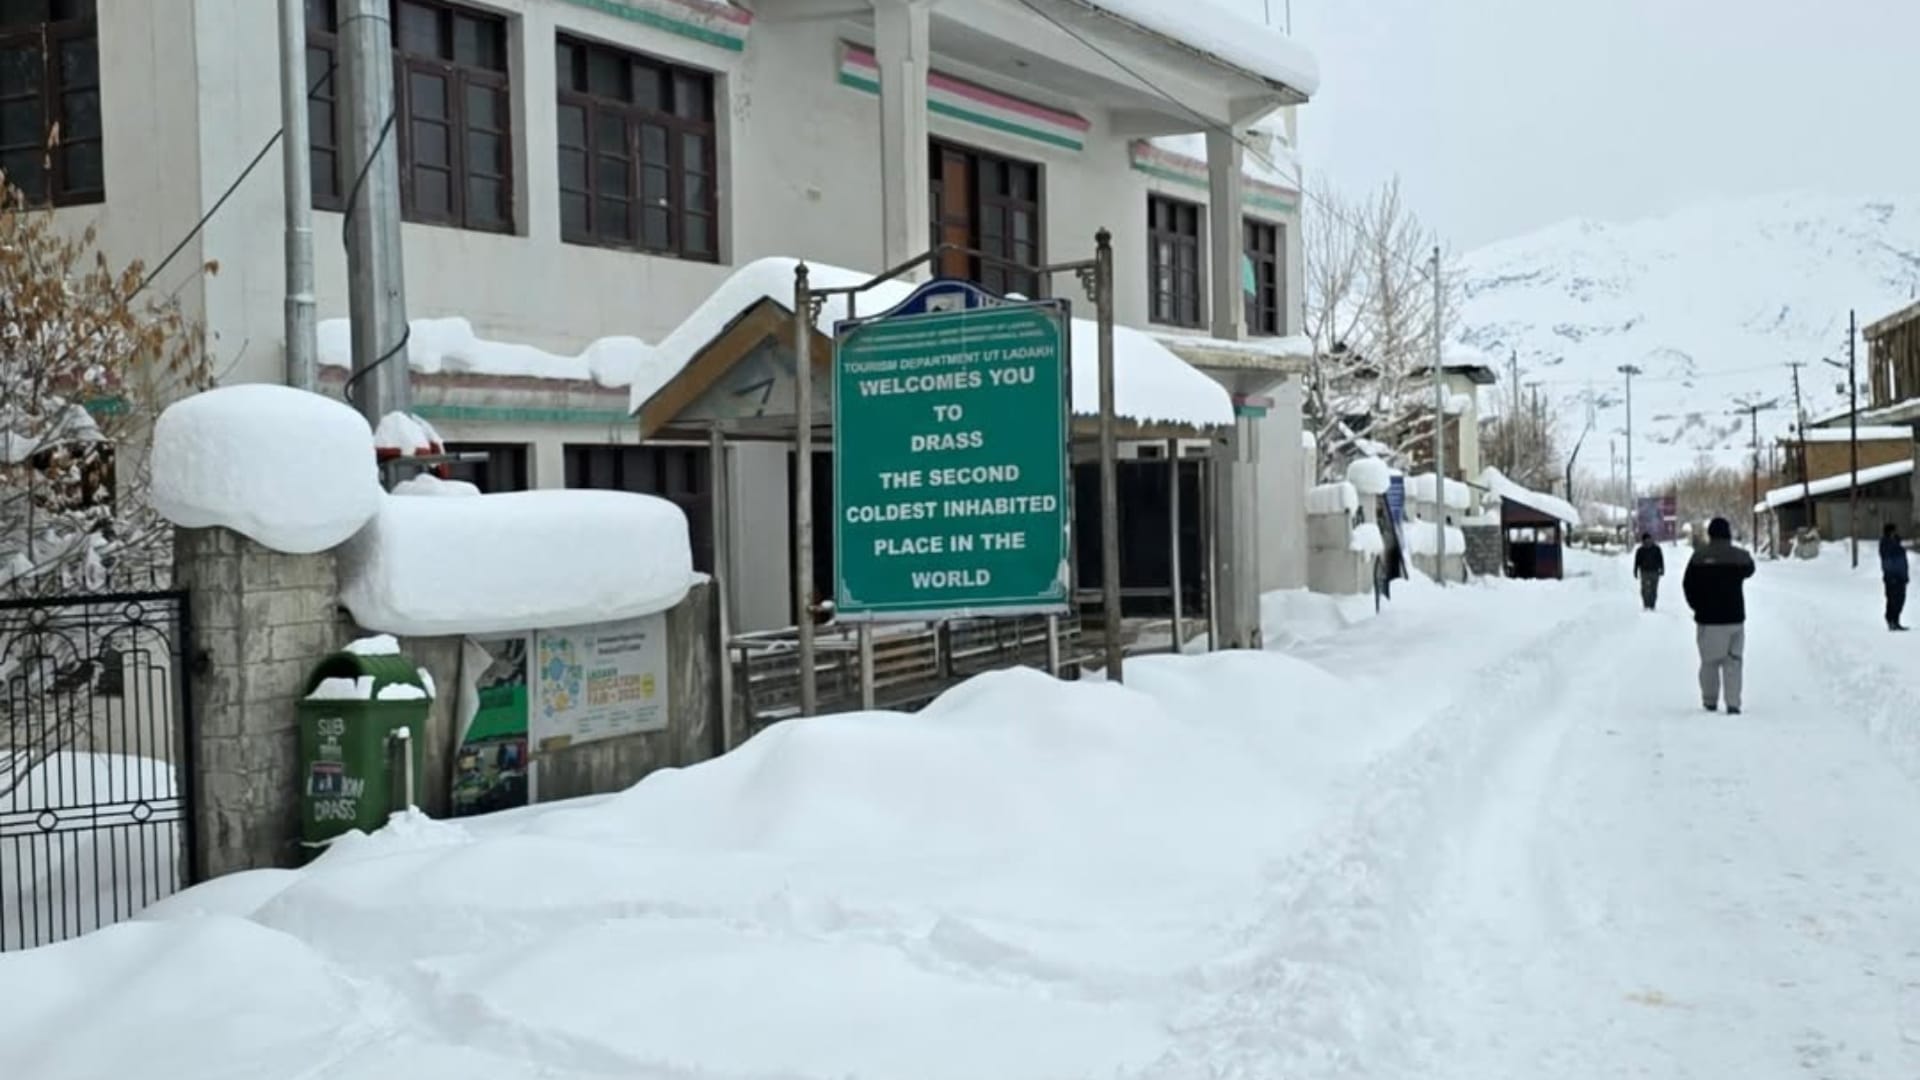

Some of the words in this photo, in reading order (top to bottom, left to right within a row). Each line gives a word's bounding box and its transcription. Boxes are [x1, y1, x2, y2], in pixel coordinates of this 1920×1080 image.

[843, 360, 898, 374] TOURISM
[900, 352, 980, 369] DEPARTMENT
[983, 349, 1000, 361] UT
[1002, 345, 1055, 360] LADAKH
[859, 370, 982, 396] WELCOMES
[989, 366, 1035, 385] YOU
[933, 404, 963, 422] TO
[911, 431, 984, 451] DRASS
[879, 471, 923, 489] THE
[929, 465, 1020, 486] SECOND
[846, 502, 938, 523] COLDEST
[944, 495, 1057, 517] INHABITED
[874, 537, 943, 556] PLACE
[951, 535, 973, 552] IN
[981, 532, 1026, 550] THE
[912, 569, 991, 589] WORLD
[318, 718, 345, 735] SUB
[314, 799, 356, 822] DRASS
